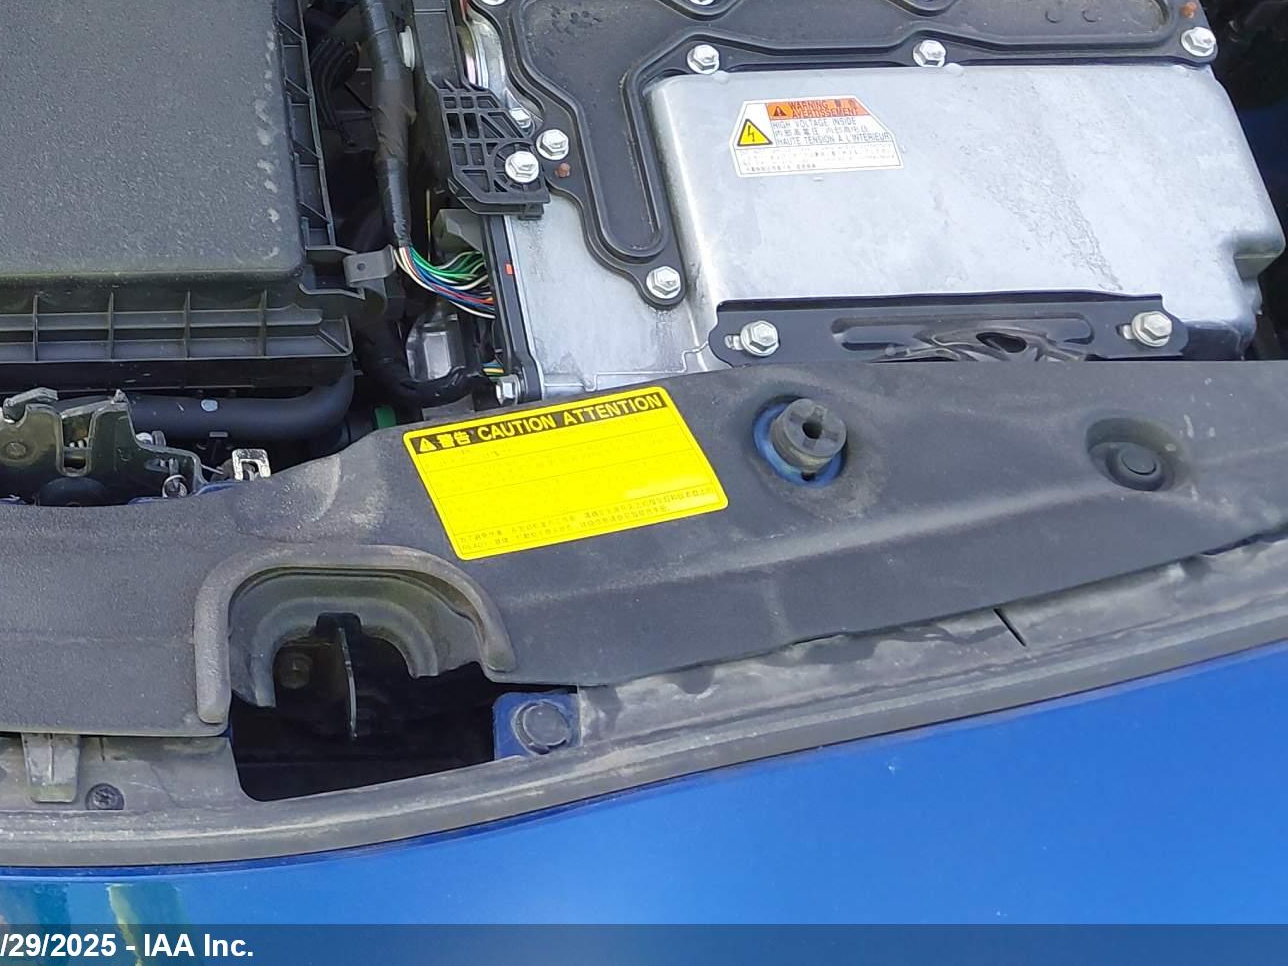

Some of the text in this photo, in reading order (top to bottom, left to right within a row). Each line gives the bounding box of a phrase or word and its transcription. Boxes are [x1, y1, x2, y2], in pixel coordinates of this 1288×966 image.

[788, 99, 828, 110] WARNING
[792, 107, 858, 119] AVERTISSEMENT
[772, 117, 857, 129] HIGH VOLTAGE INSIDE
[776, 137, 801, 145] HAUTE
[804, 134, 836, 144] TENSION
[436, 392, 663, 449] 警告 CAUTION ATTENTION
